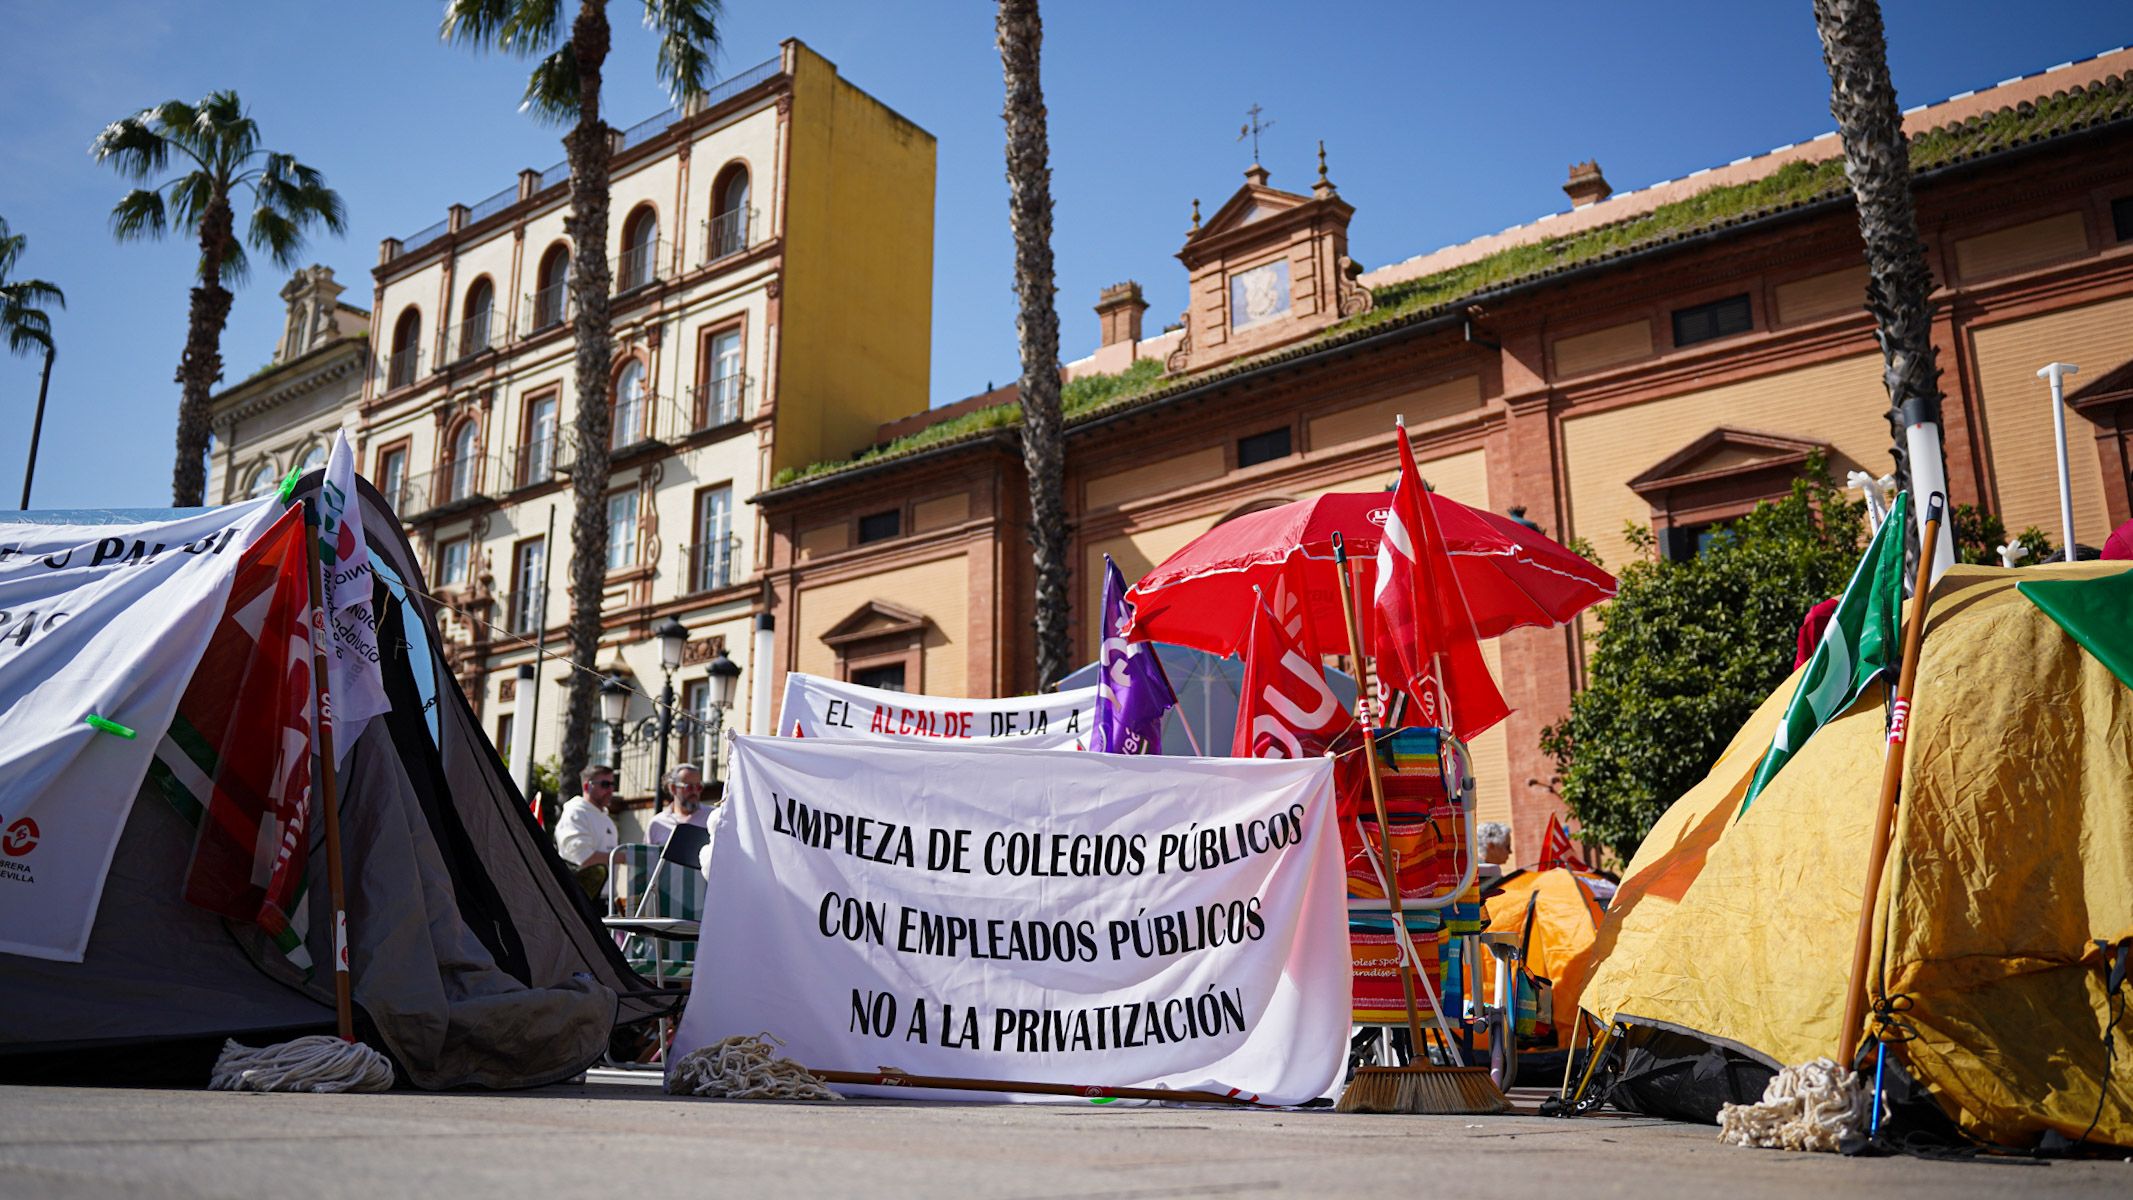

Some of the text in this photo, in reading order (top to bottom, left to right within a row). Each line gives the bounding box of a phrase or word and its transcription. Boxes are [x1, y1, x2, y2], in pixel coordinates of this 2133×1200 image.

[825, 699, 1081, 739] EL ALCALDE DEJA A
[771, 791, 1305, 877] LIMPIEZA DE COLEGIOS PÚBLICOS
[818, 890, 1265, 963] CON EMPLEADOS PÚBLICOS
[849, 983, 1247, 1053] NO A LA PRIVATIZACIÓN
